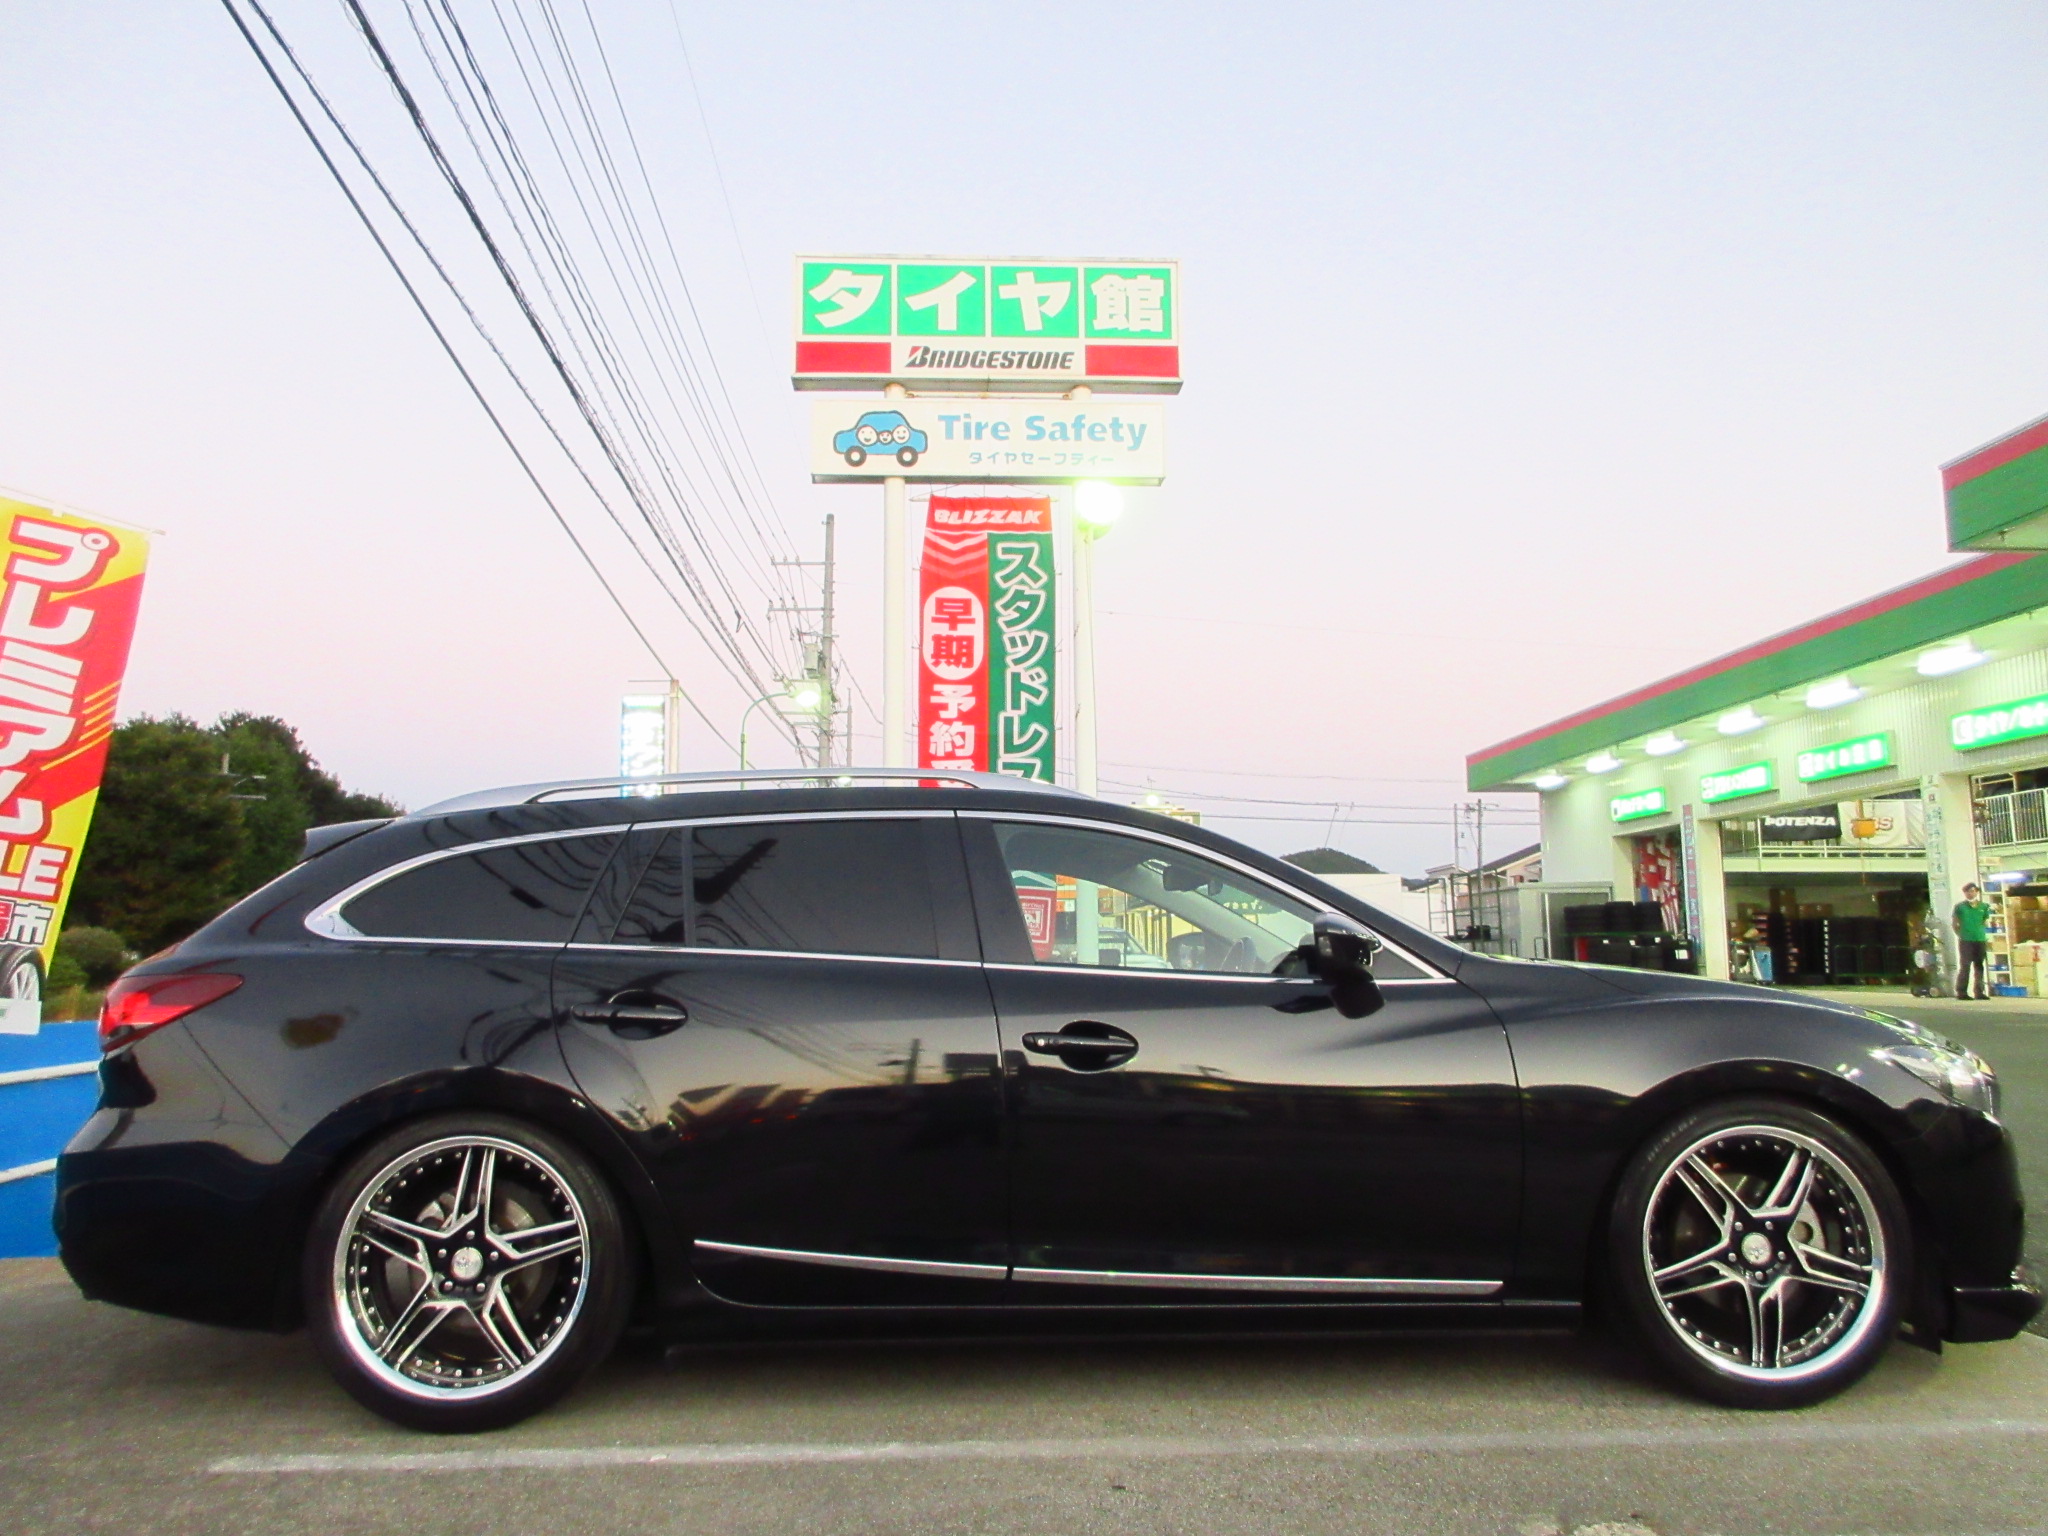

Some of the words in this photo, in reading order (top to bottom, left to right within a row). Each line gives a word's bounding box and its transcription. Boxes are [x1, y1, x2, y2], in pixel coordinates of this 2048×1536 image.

[808, 268, 1165, 332] タイヤ館
[905, 345, 1075, 370] BRIDGESTONE
[937, 414, 1011, 441] Tire
[1025, 413, 1147, 451] Safety
[969, 451, 1114, 466] タイヤセーフティー
[933, 508, 1044, 525] BLIZZAK
[1763, 815, 1837, 827] POTENZA
